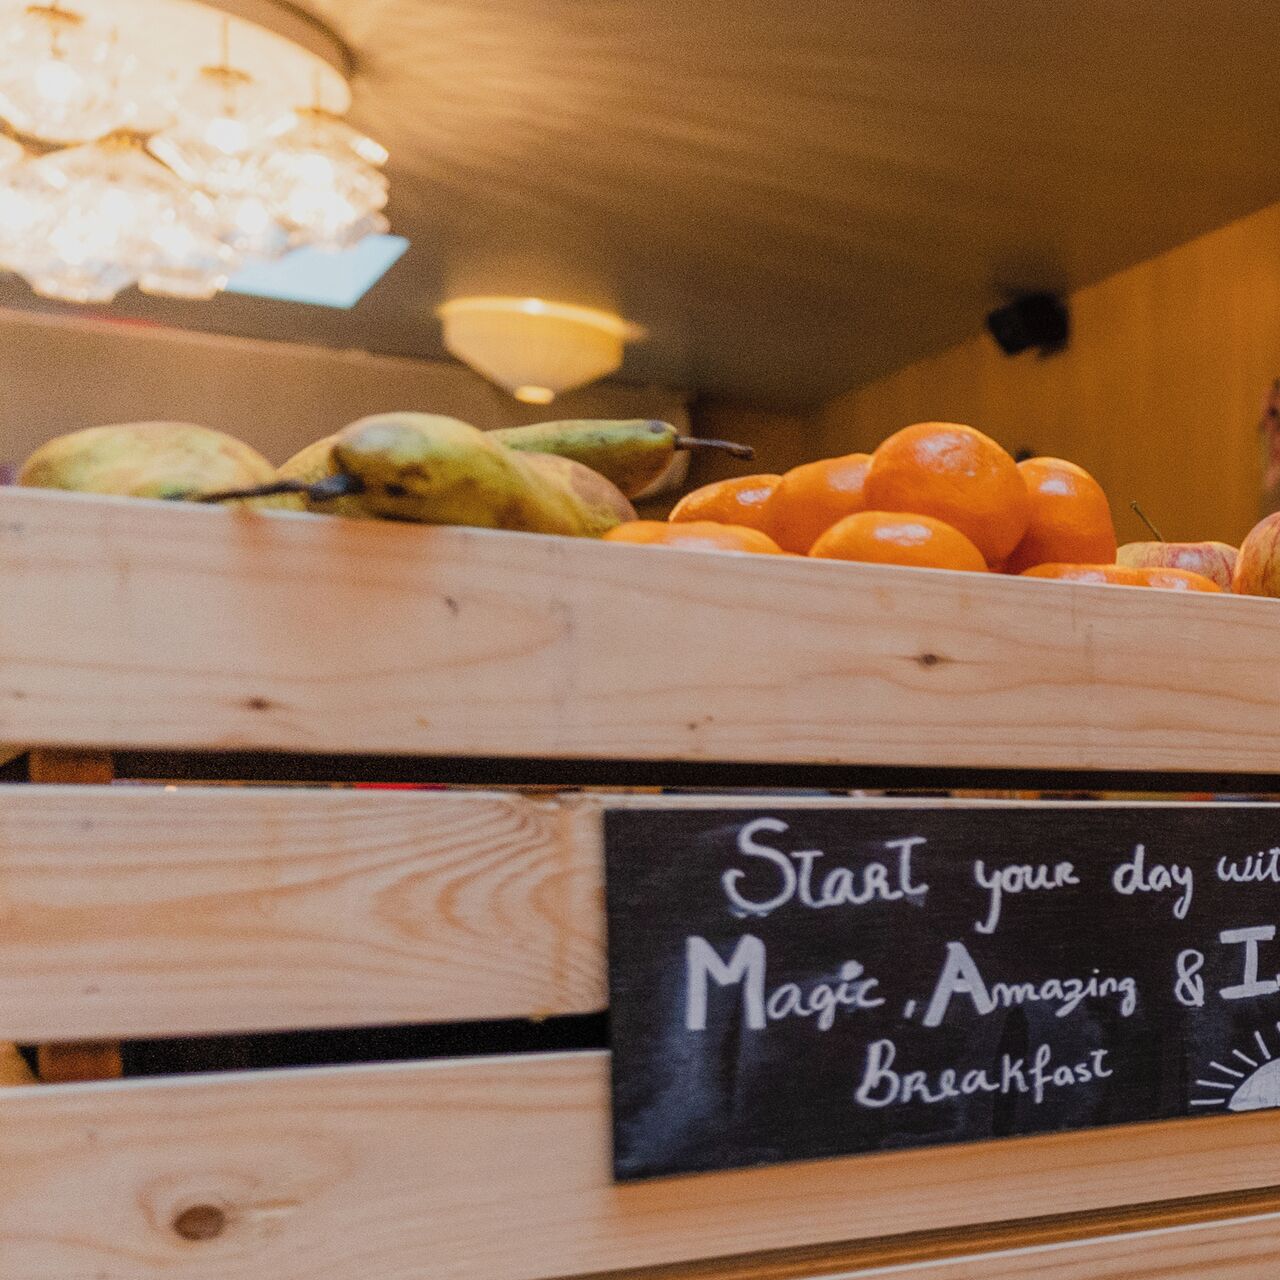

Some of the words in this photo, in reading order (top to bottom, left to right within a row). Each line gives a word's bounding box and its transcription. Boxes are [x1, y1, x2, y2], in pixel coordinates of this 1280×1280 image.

[723, 817, 928, 918] Start
[974, 860, 1079, 935] your
[1113, 844, 1194, 919] day
[923, 941, 1137, 1028] Amazing
[1175, 948, 1206, 1007] &
[855, 1038, 1113, 1108] Breakfast
